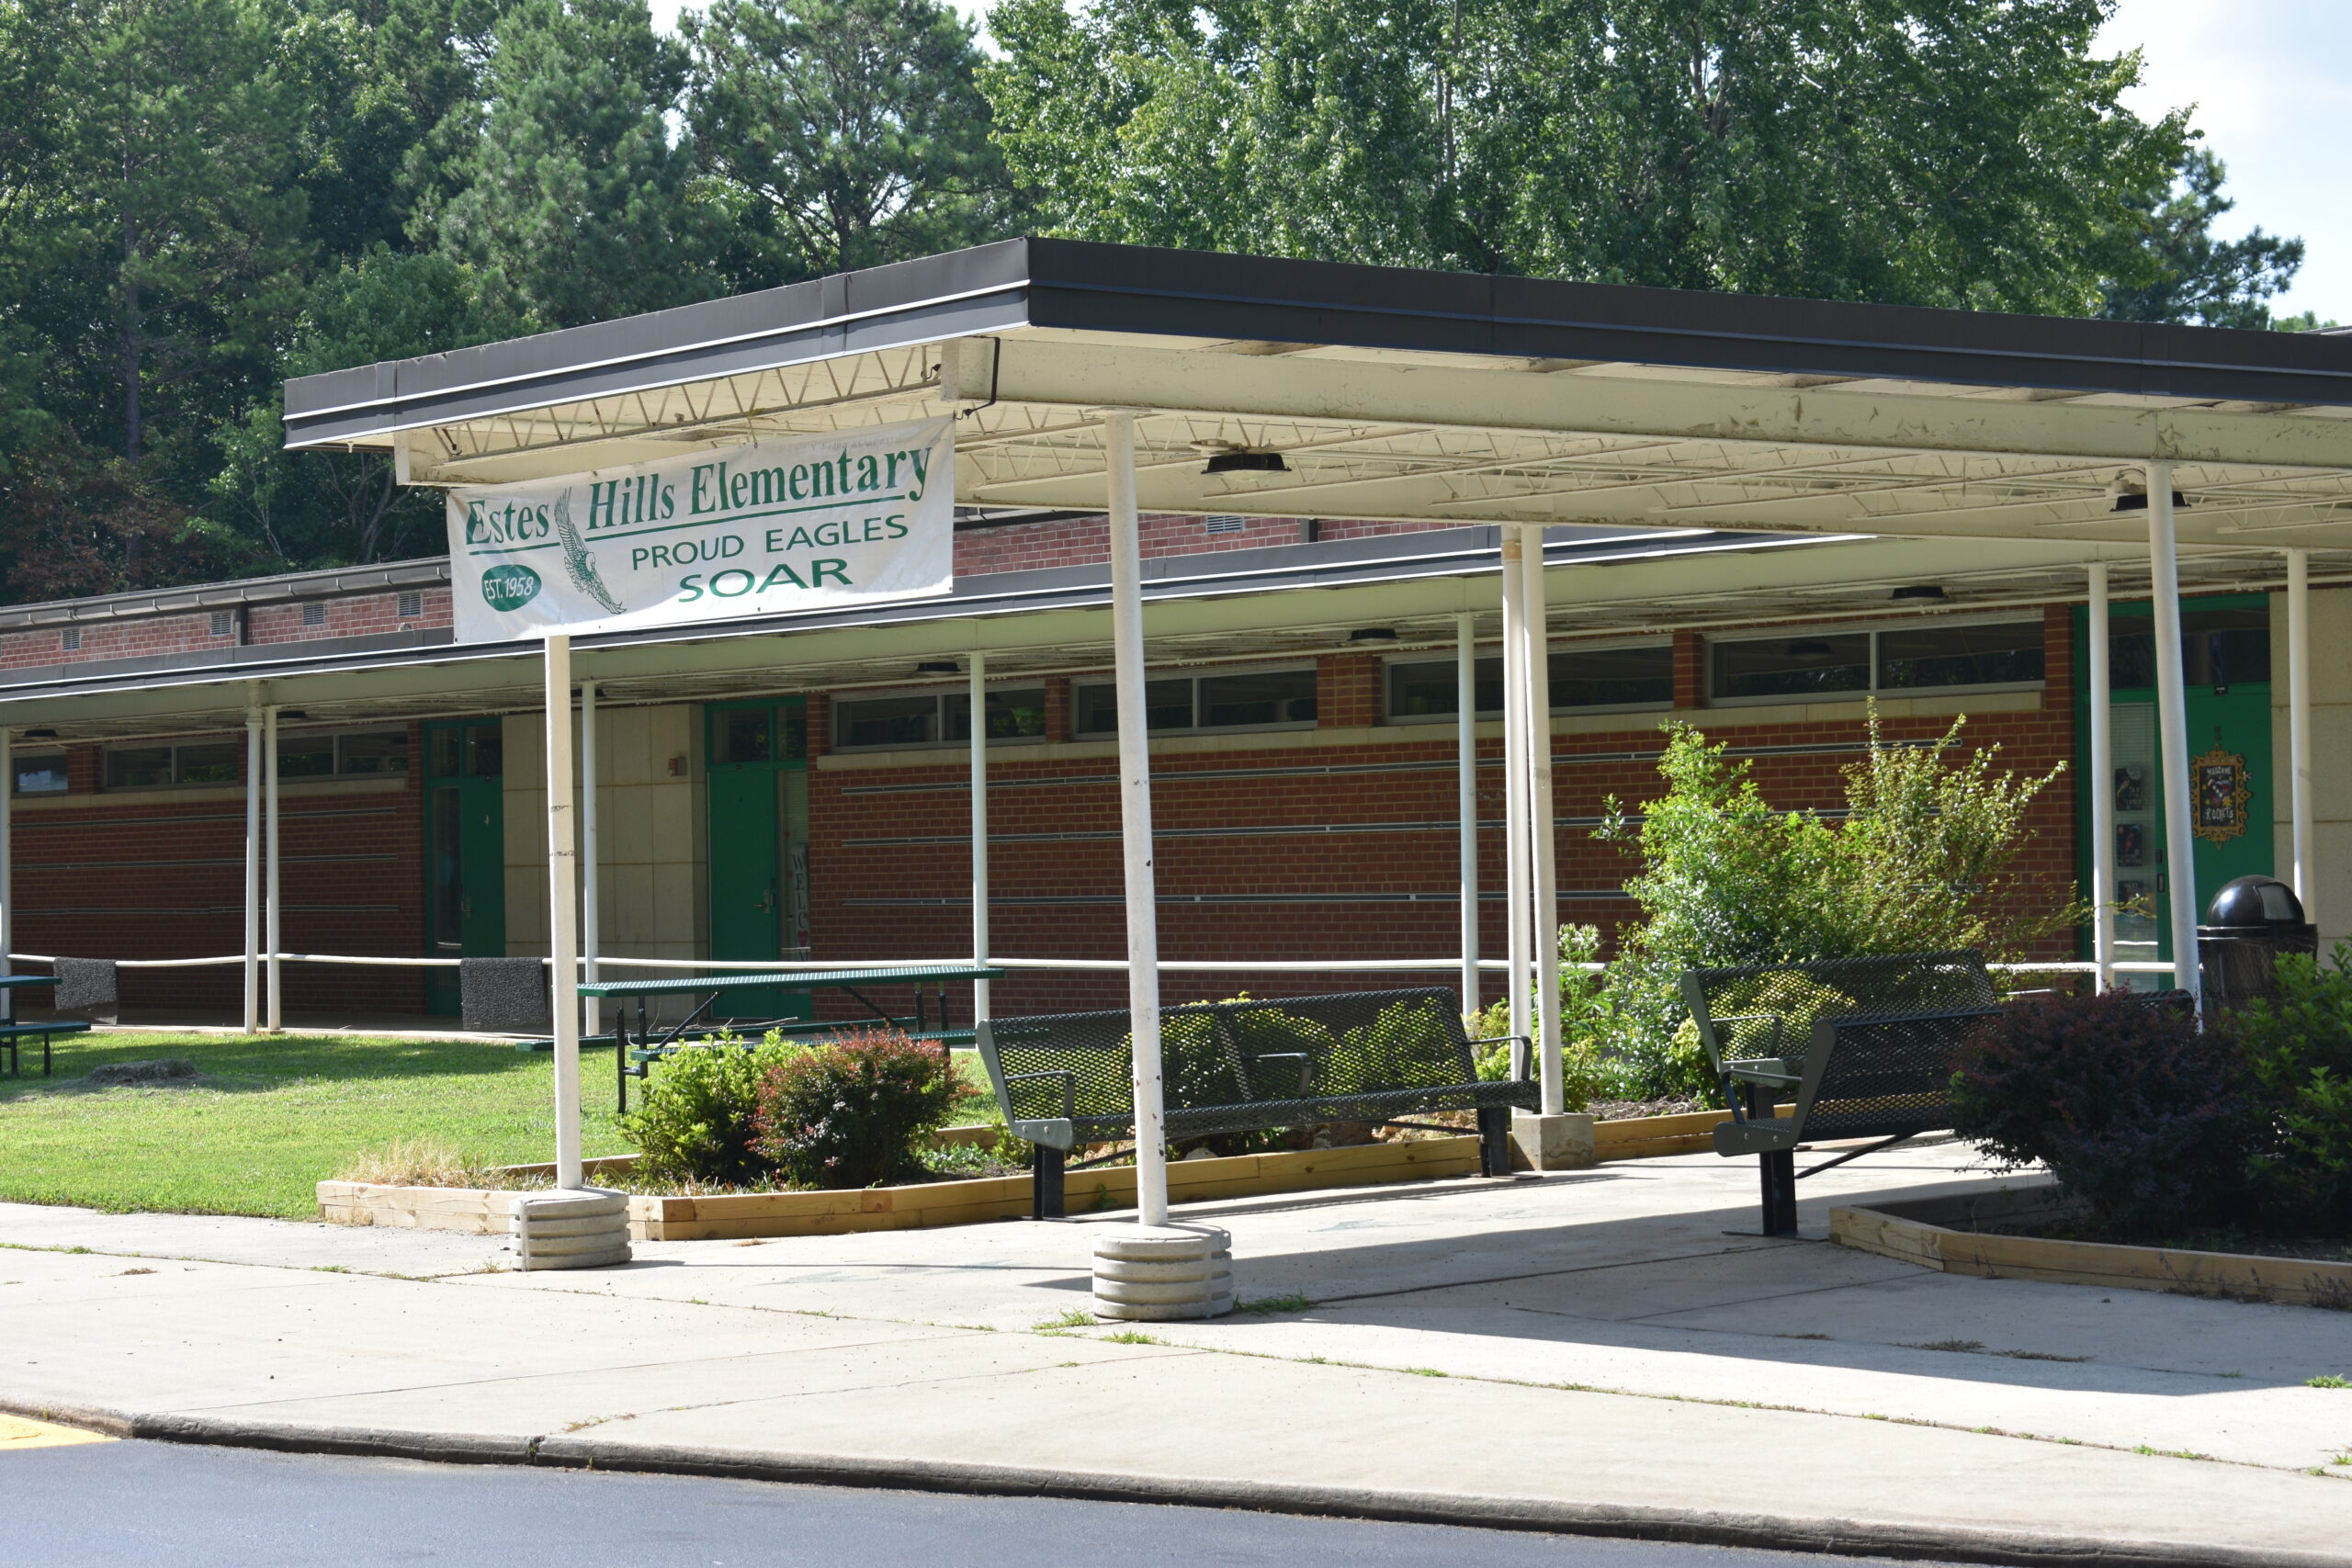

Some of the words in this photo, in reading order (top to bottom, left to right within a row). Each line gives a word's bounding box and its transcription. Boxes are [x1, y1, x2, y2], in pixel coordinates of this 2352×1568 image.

[466, 500, 549, 546] Estes
[586, 473, 675, 531] Hills
[688, 446, 933, 516] Elementary
[632, 535, 744, 570] PROUD
[765, 514, 909, 552] EAGLES
[483, 579, 503, 600] EST.
[504, 576, 535, 597] 1958
[678, 558, 854, 603] SOAR
[792, 855, 809, 974] WELCM
